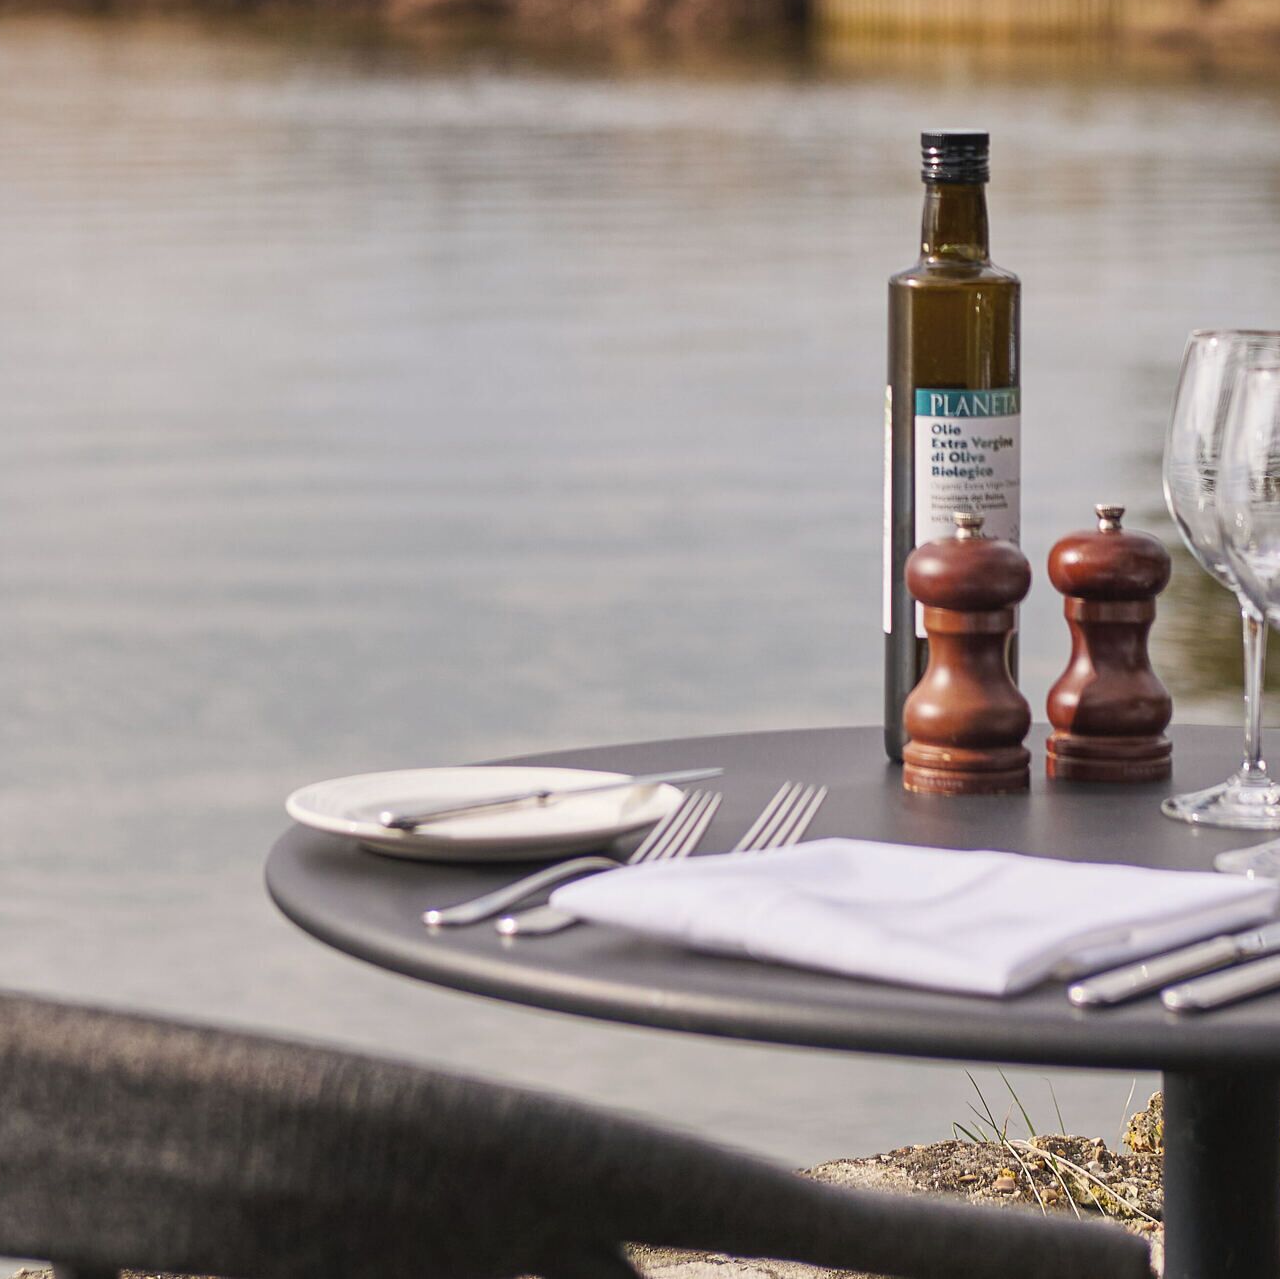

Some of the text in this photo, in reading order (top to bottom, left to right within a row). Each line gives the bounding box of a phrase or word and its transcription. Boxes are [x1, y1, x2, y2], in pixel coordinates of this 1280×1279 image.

[930, 393, 1018, 416] PLANETA
[931, 424, 961, 436] Olio
[931, 435, 1014, 452] Extra Vergine
[931, 451, 986, 463] di Oliva
[931, 465, 994, 480] Biologico
